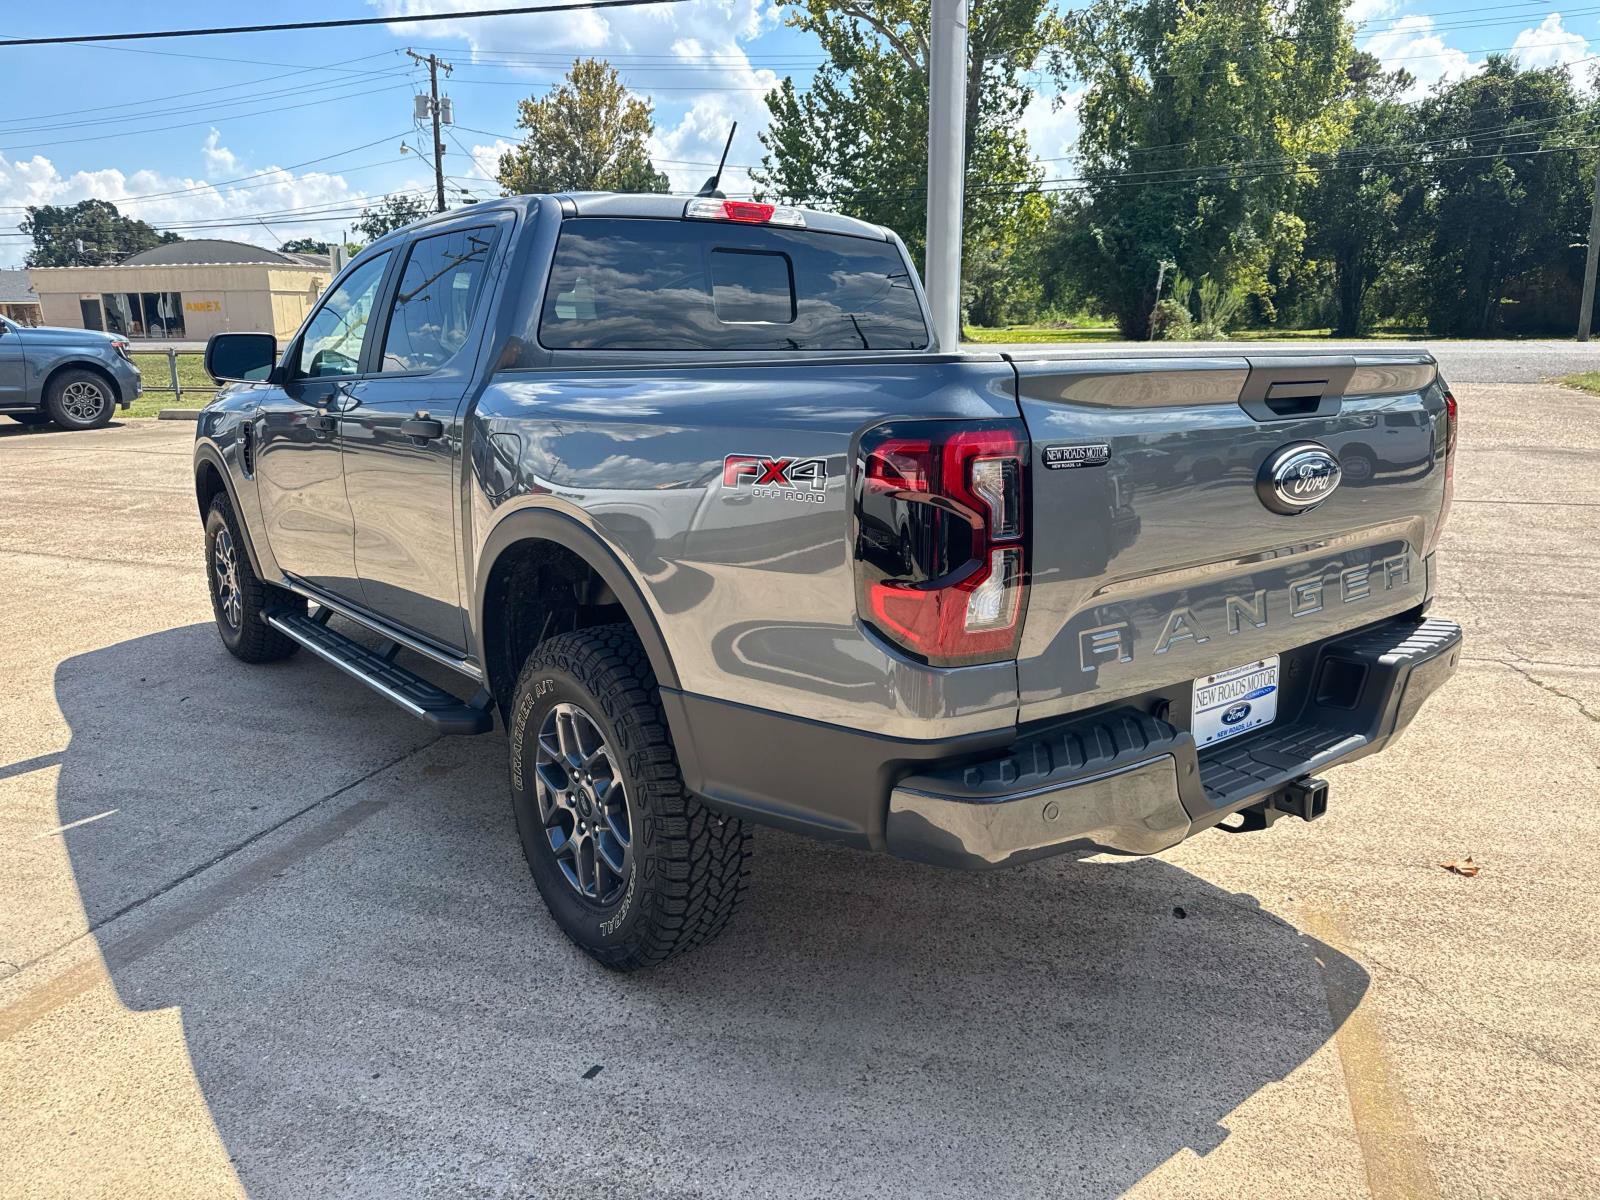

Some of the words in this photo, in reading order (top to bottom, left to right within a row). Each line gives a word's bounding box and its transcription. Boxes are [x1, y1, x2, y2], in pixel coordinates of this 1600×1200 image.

[185, 301, 221, 312] ANNEX
[1047, 450, 1062, 461] NEW
[1063, 448, 1086, 460] ROADS
[1086, 446, 1109, 458] MOTOR
[722, 453, 828, 492] FX4
[1294, 464, 1331, 493] Ford
[752, 488, 780, 499] OFF
[785, 491, 826, 503] ROAD
[1079, 552, 1410, 672] RANGER
[1196, 688, 1217, 708] NEW
[1218, 679, 1246, 701] ROADS
[1247, 670, 1276, 692] MOTOR
[1227, 707, 1247, 722] Ford
[513, 693, 535, 791] GRABBER
[1217, 730, 1228, 738] NEW
